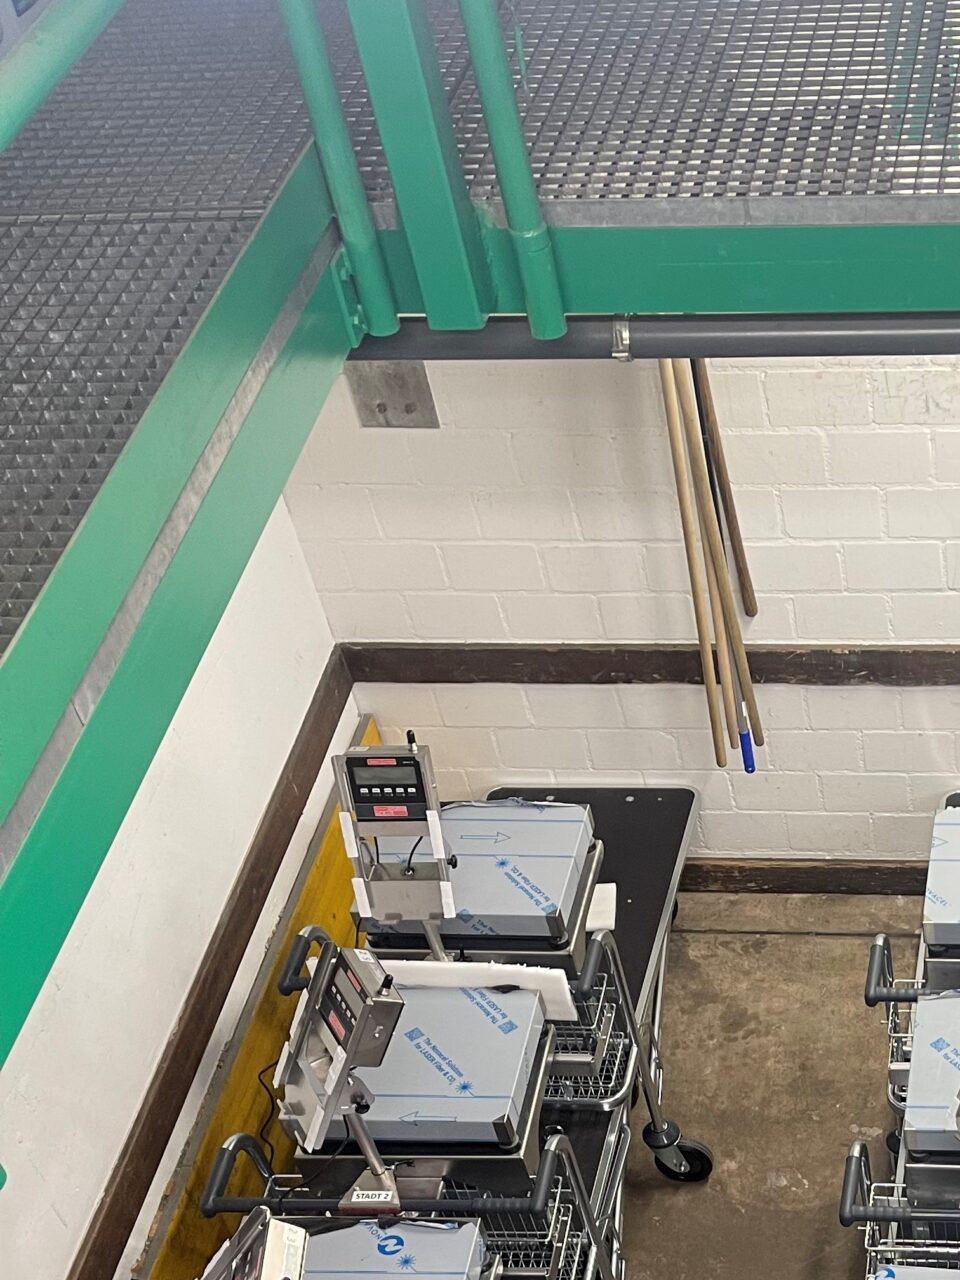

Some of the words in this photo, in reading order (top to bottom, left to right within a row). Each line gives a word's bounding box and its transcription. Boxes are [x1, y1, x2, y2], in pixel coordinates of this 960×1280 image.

[420, 1048, 436, 1063] LASER
[433, 1061, 445, 1072] Fiber
[423, 1037, 432, 1046] The
[430, 1045, 449, 1061] Novacel
[446, 1060, 463, 1077] Solution
